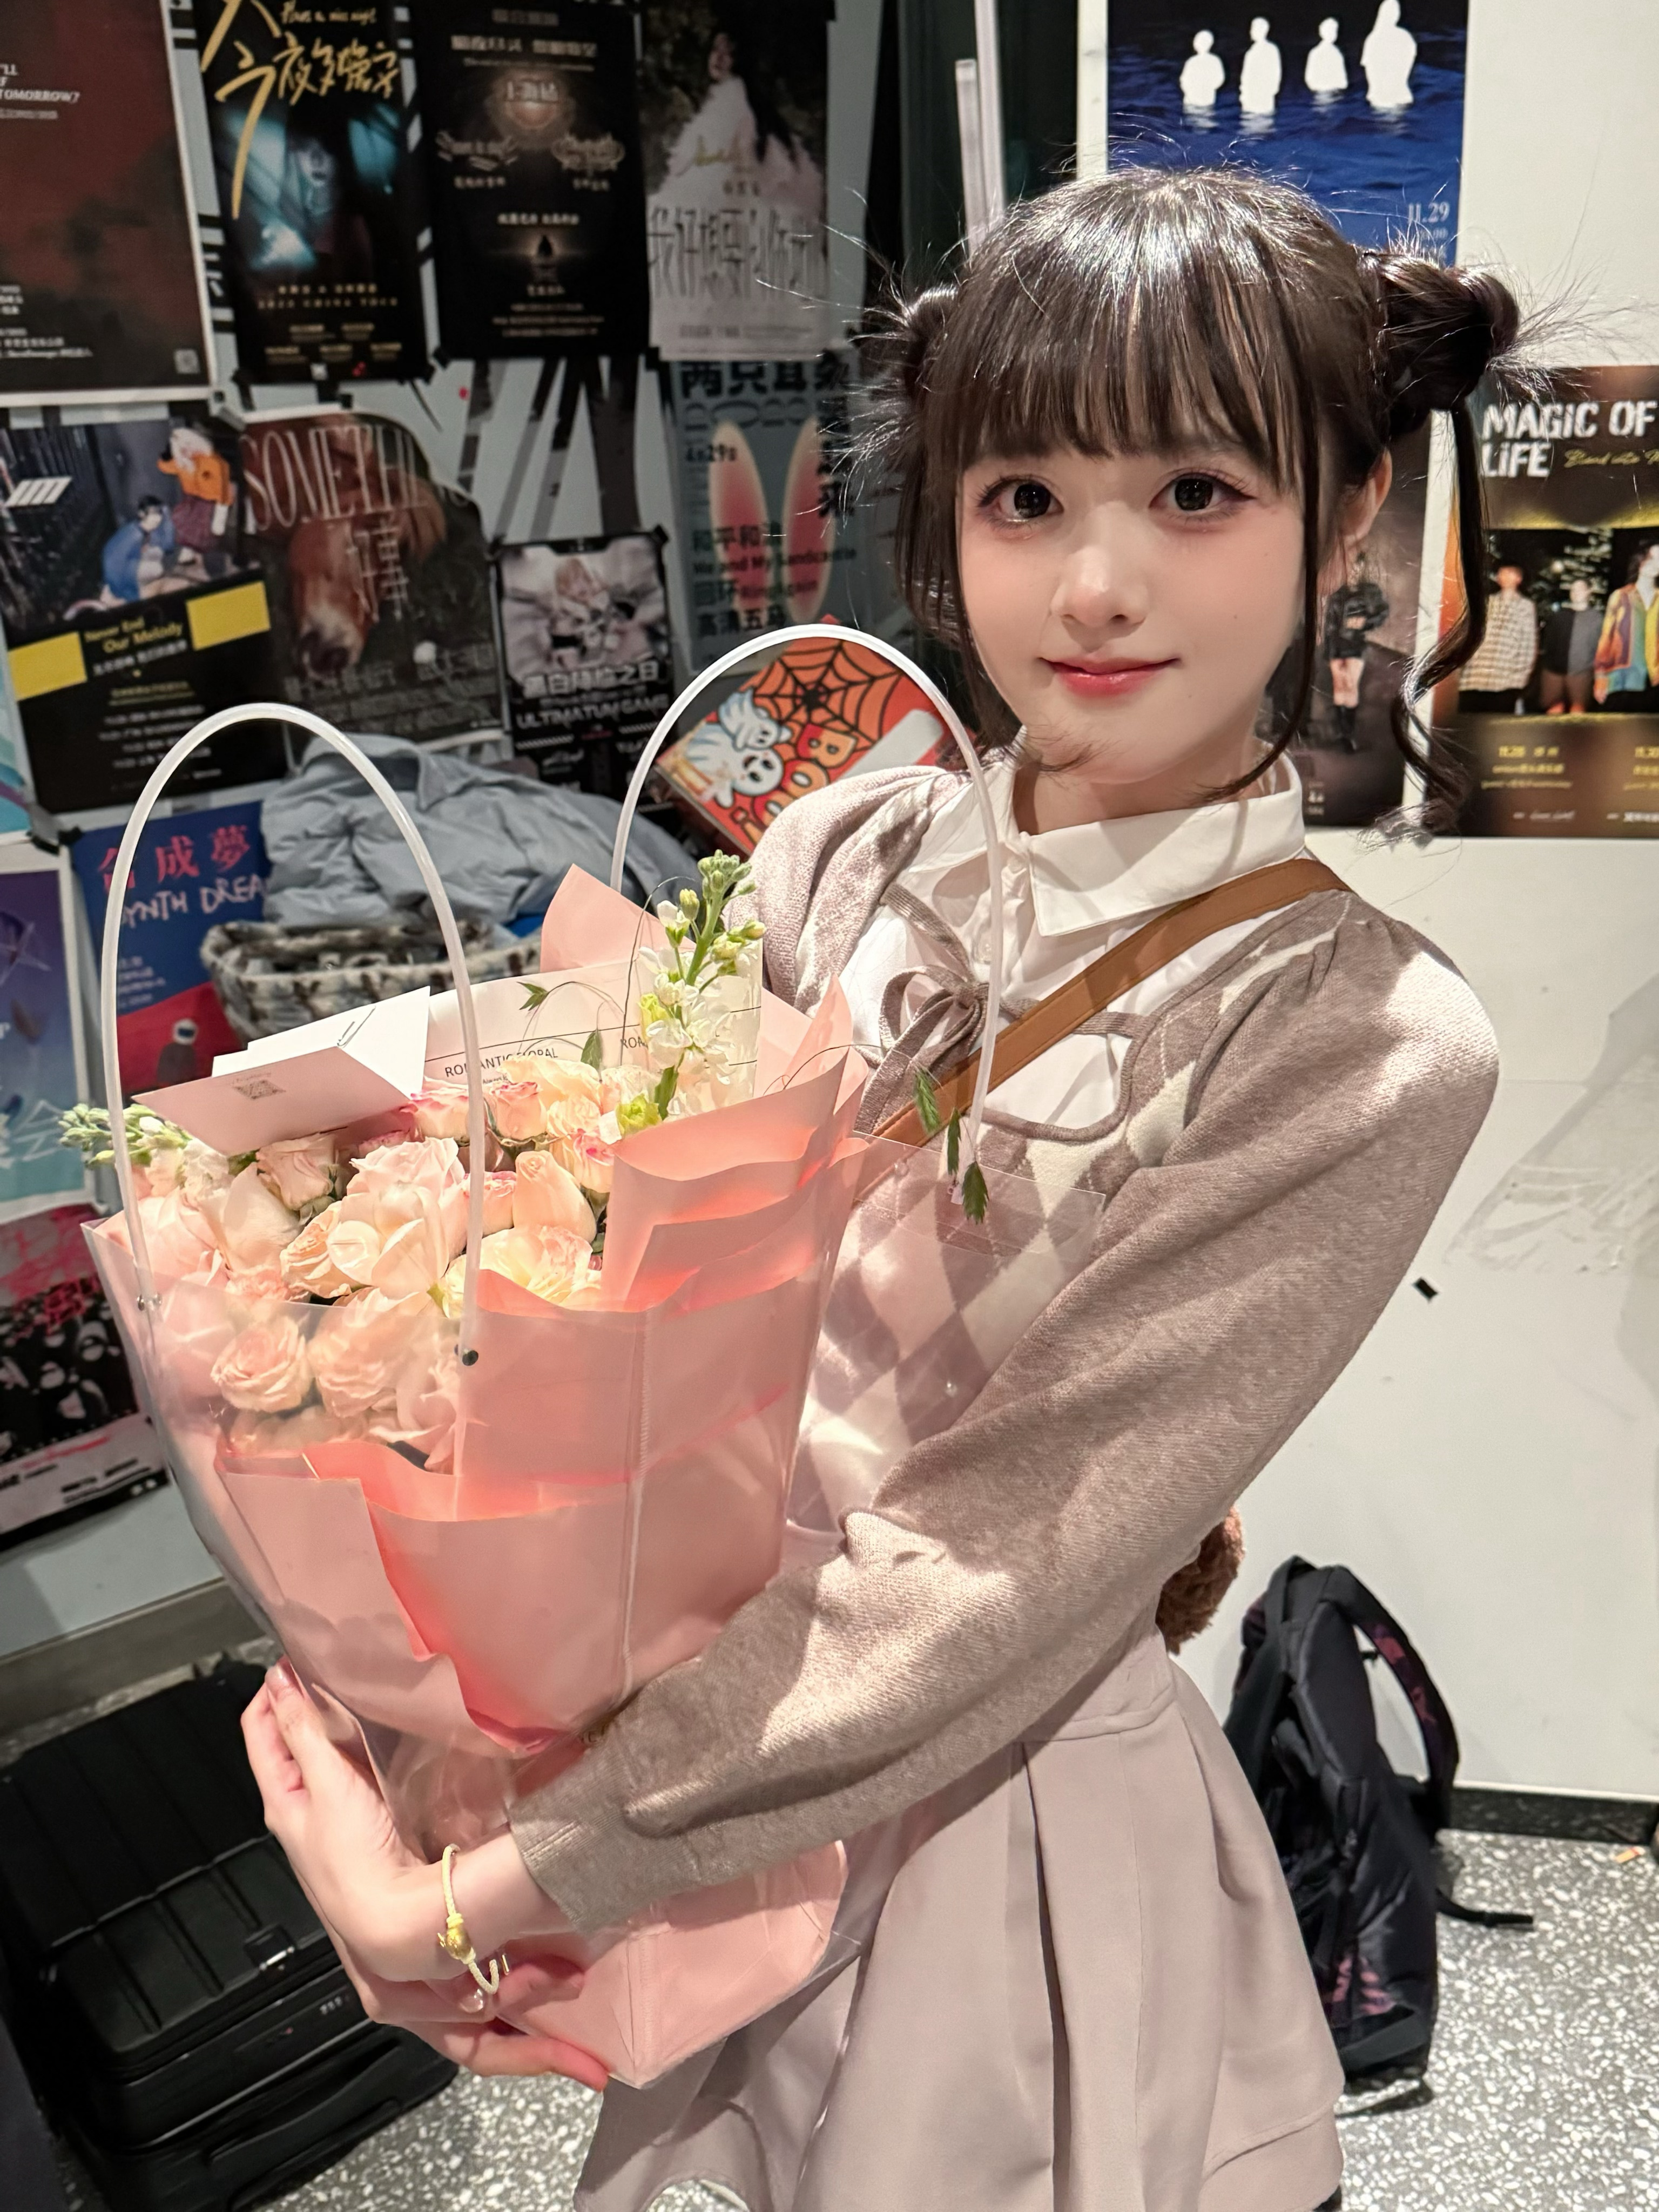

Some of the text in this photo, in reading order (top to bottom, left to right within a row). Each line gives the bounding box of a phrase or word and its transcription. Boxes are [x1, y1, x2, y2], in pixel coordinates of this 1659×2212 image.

[1408, 201, 1450, 222] 11.29
[1482, 401, 1658, 440] MAGIC OF
[123, 873, 266, 928] YNTH DREA
